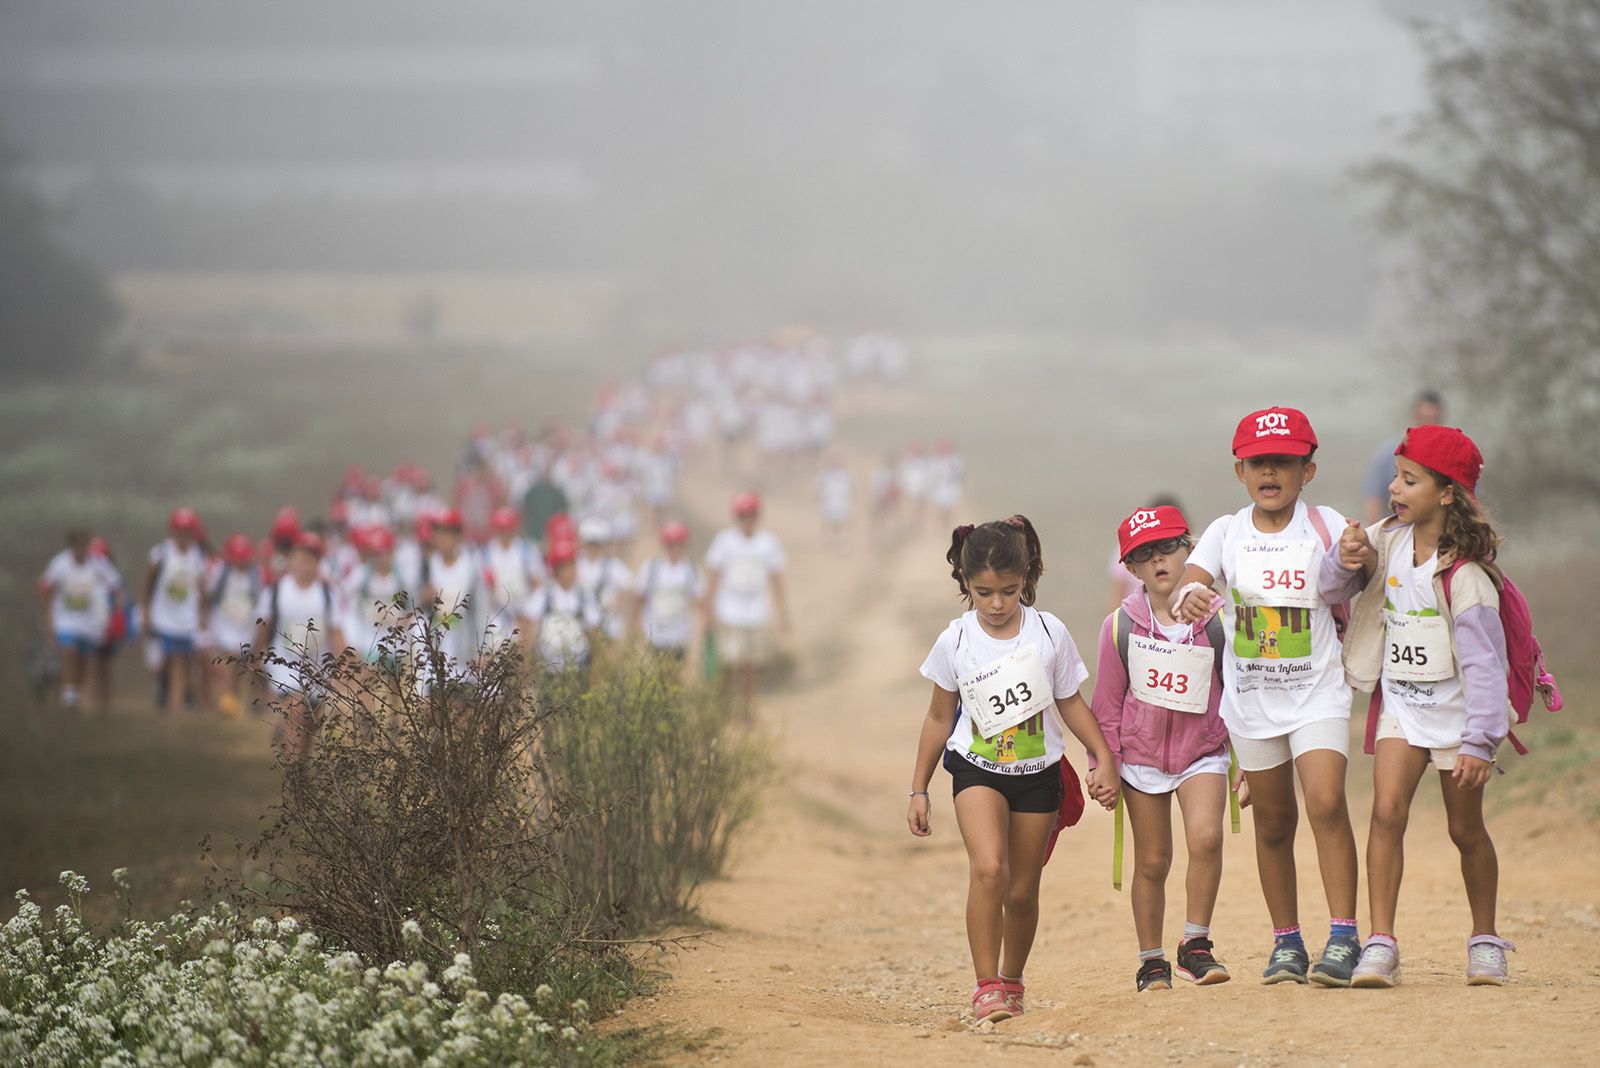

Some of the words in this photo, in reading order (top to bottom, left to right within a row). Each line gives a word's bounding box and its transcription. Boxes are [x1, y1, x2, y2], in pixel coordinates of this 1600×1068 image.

[1256, 413, 1288, 429] TOT
[1129, 510, 1157, 530] TOT
[1262, 569, 1306, 590] 345
[1135, 641, 1147, 649] "La
[1148, 643, 1177, 654] Marxa"
[1391, 643, 1428, 666] 345
[1246, 663, 1276, 673] Marxa
[1277, 661, 1313, 675] Infantil
[1146, 668, 1189, 694] 343
[988, 681, 1032, 715] 343
[980, 760, 1011, 773] Marxa
[1013, 761, 1046, 774] Infantil
